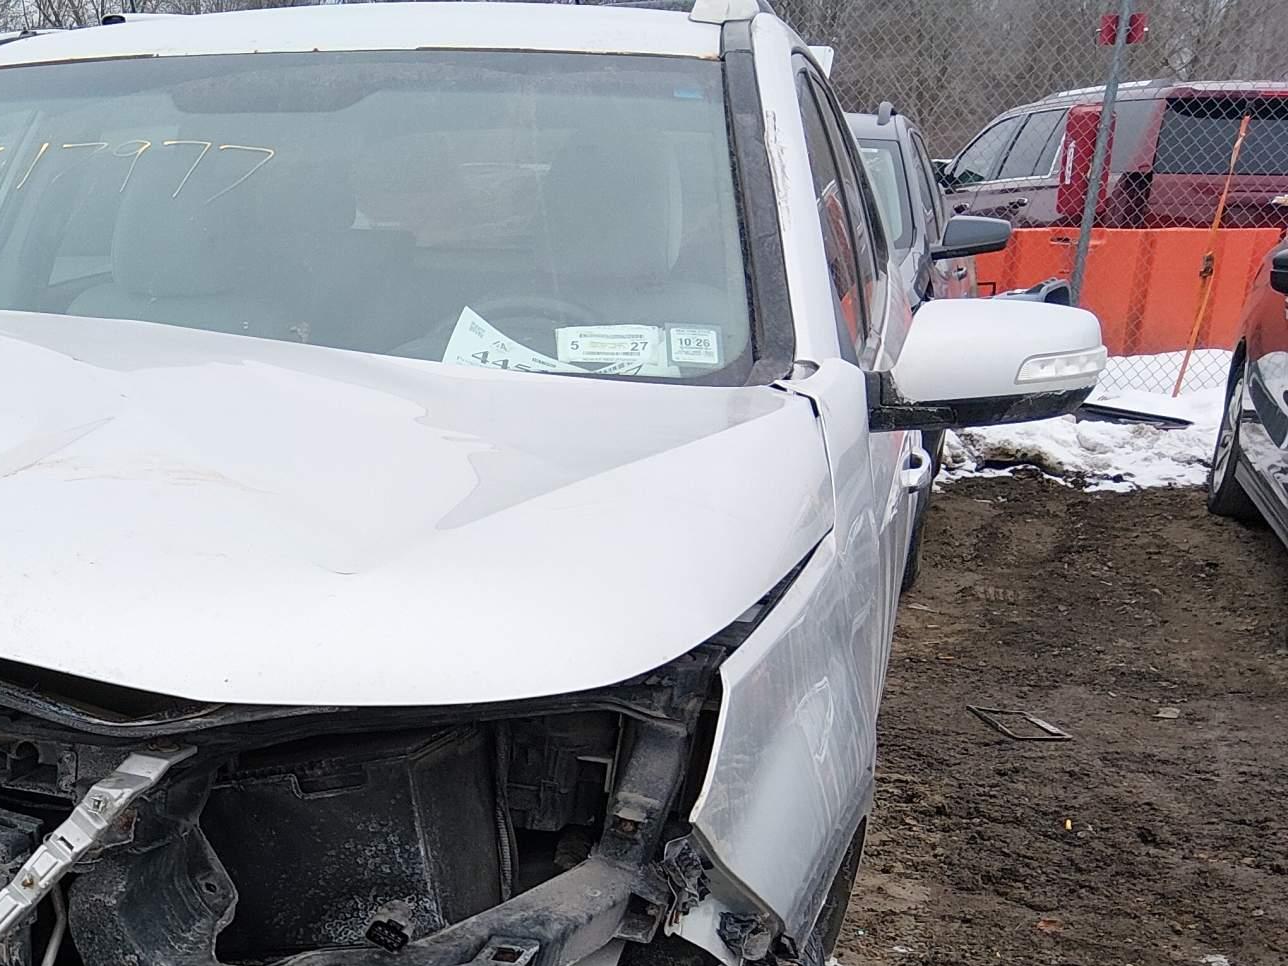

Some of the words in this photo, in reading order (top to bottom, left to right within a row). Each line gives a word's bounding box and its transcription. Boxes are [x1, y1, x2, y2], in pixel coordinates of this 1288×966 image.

[570, 340, 579, 350] 5
[630, 341, 649, 351] 27
[679, 338, 692, 346] 10
[695, 338, 711, 348] 26
